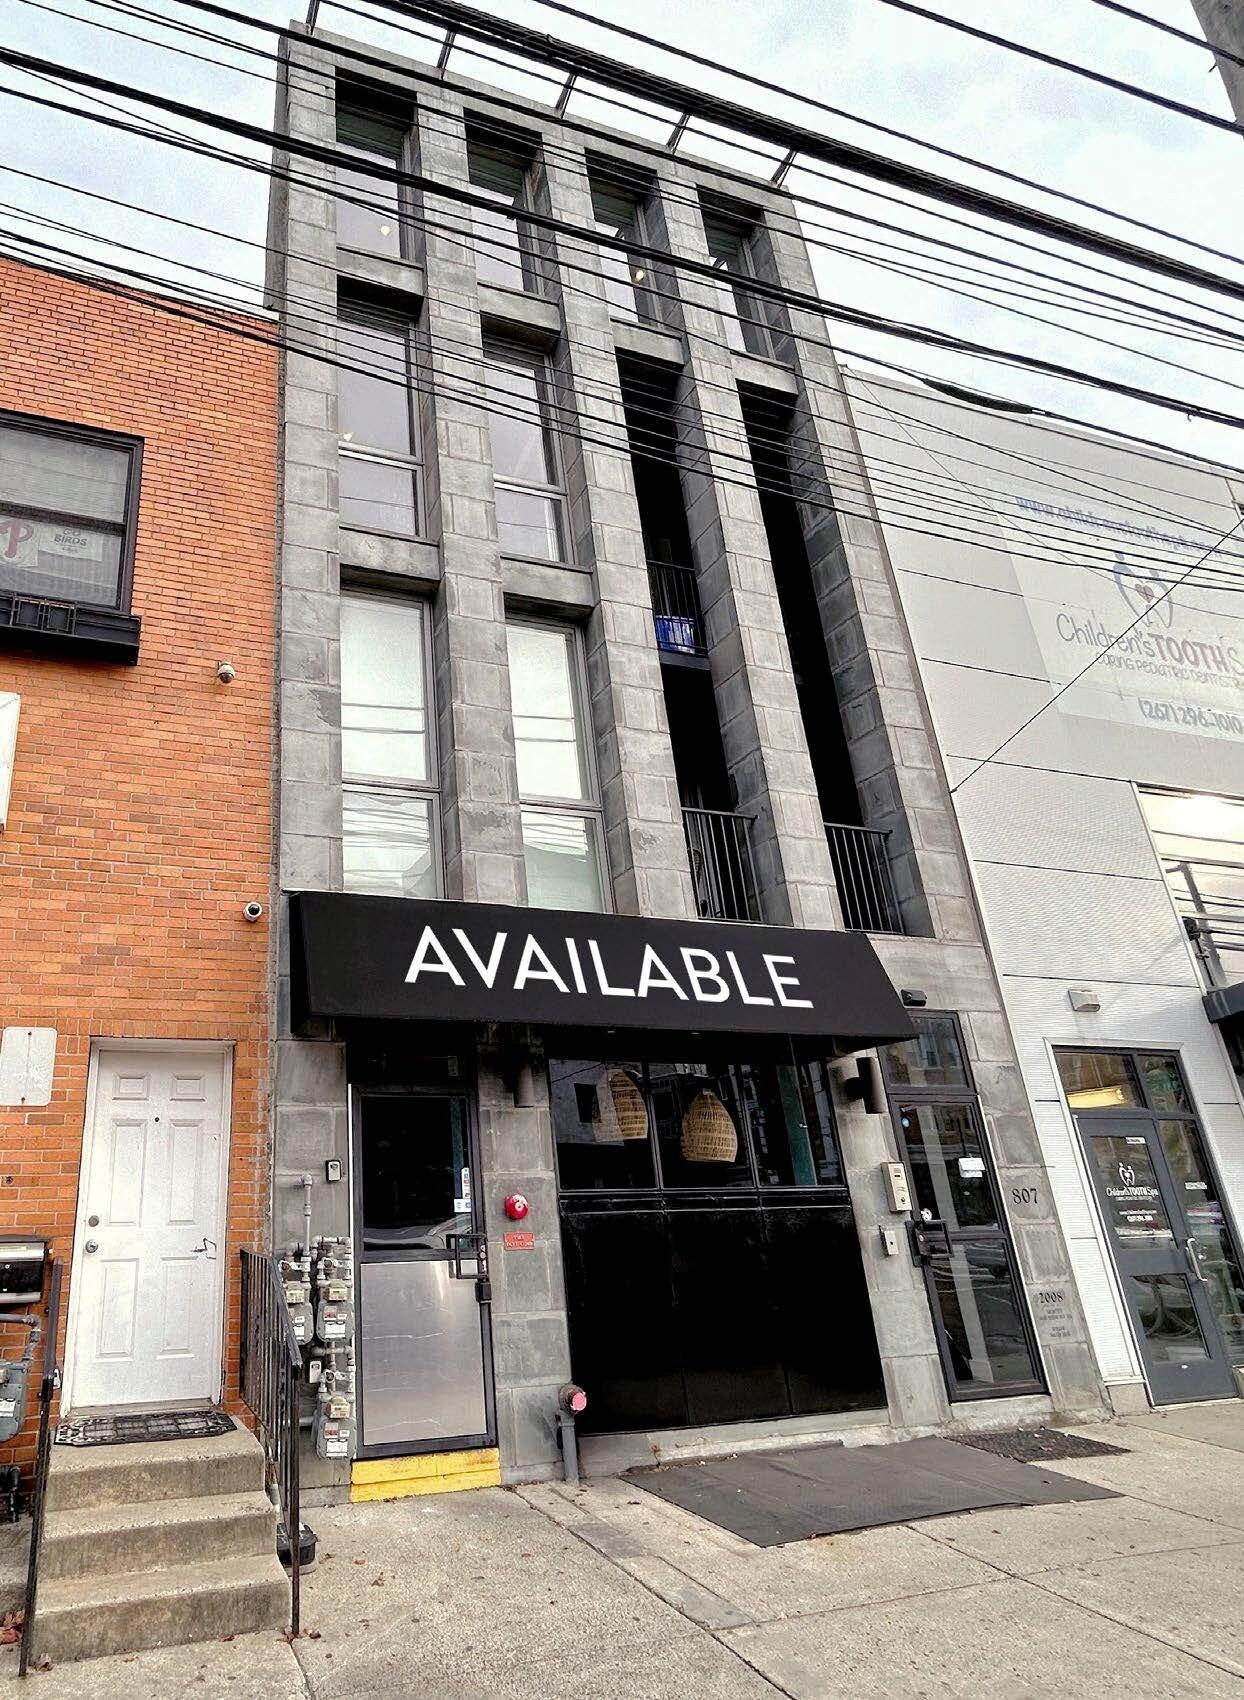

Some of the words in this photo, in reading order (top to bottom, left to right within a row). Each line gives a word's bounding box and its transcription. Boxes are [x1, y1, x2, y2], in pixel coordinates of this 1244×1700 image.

[54, 533, 88, 547] BIRDS
[1056, 613, 1155, 657] Children's
[1147, 632, 1229, 673] TOOTH
[404, 925, 814, 1009] AVAILABLE
[1011, 1188, 1038, 1205] 807
[1038, 1291, 1064, 1304] 2008
